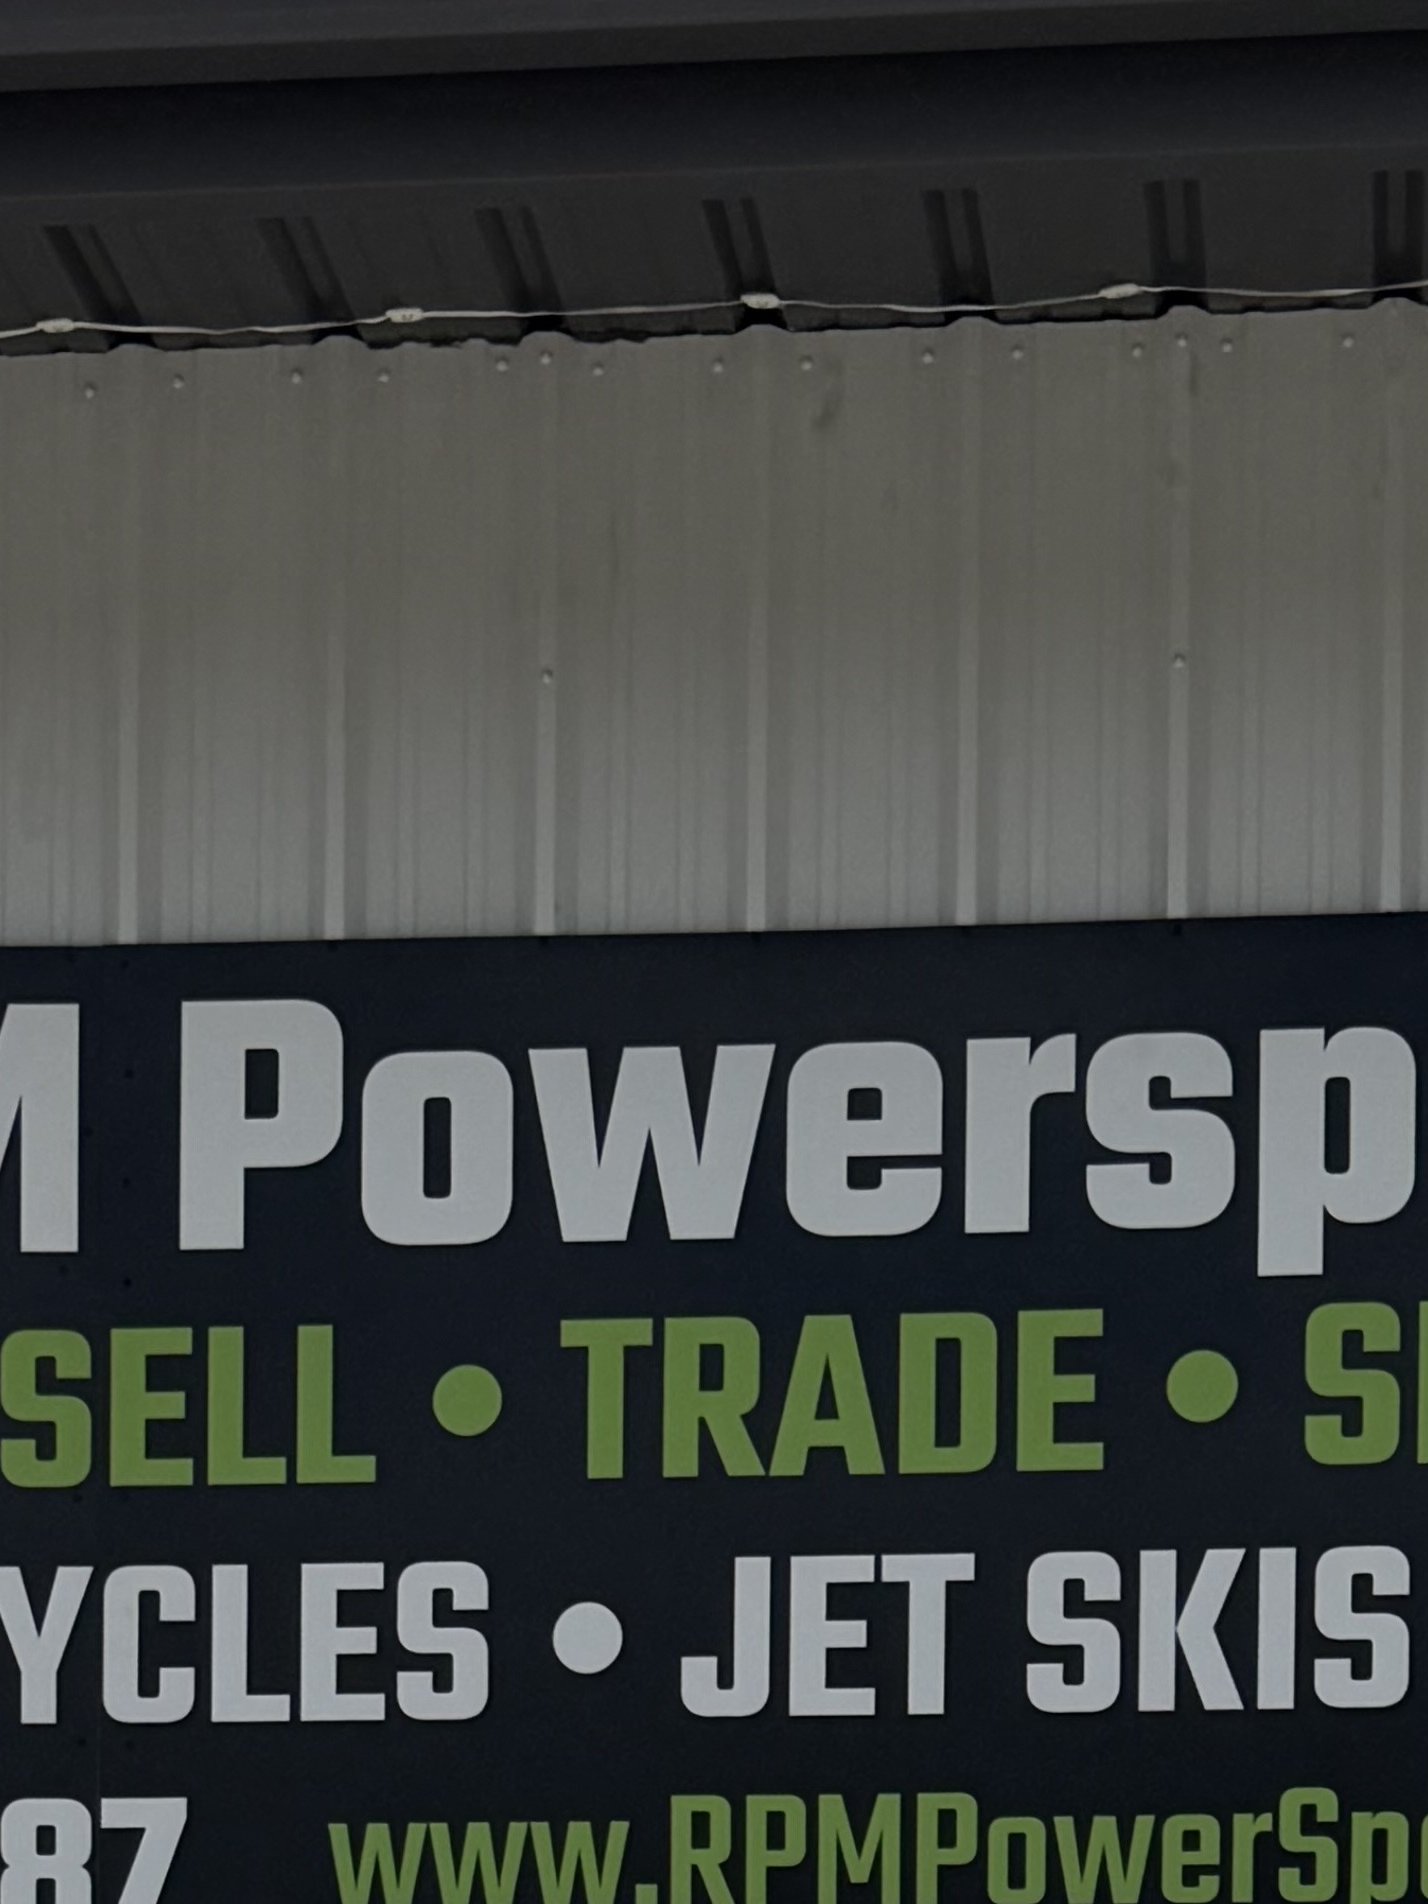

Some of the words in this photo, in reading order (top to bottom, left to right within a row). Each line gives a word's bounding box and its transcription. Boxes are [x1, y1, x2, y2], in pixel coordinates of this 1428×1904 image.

[0, 1325, 376, 1487] SELL
[561, 1309, 1103, 1478] TRADE
[681, 1553, 975, 1717] JET
[1027, 1545, 1410, 1713] SKIS
